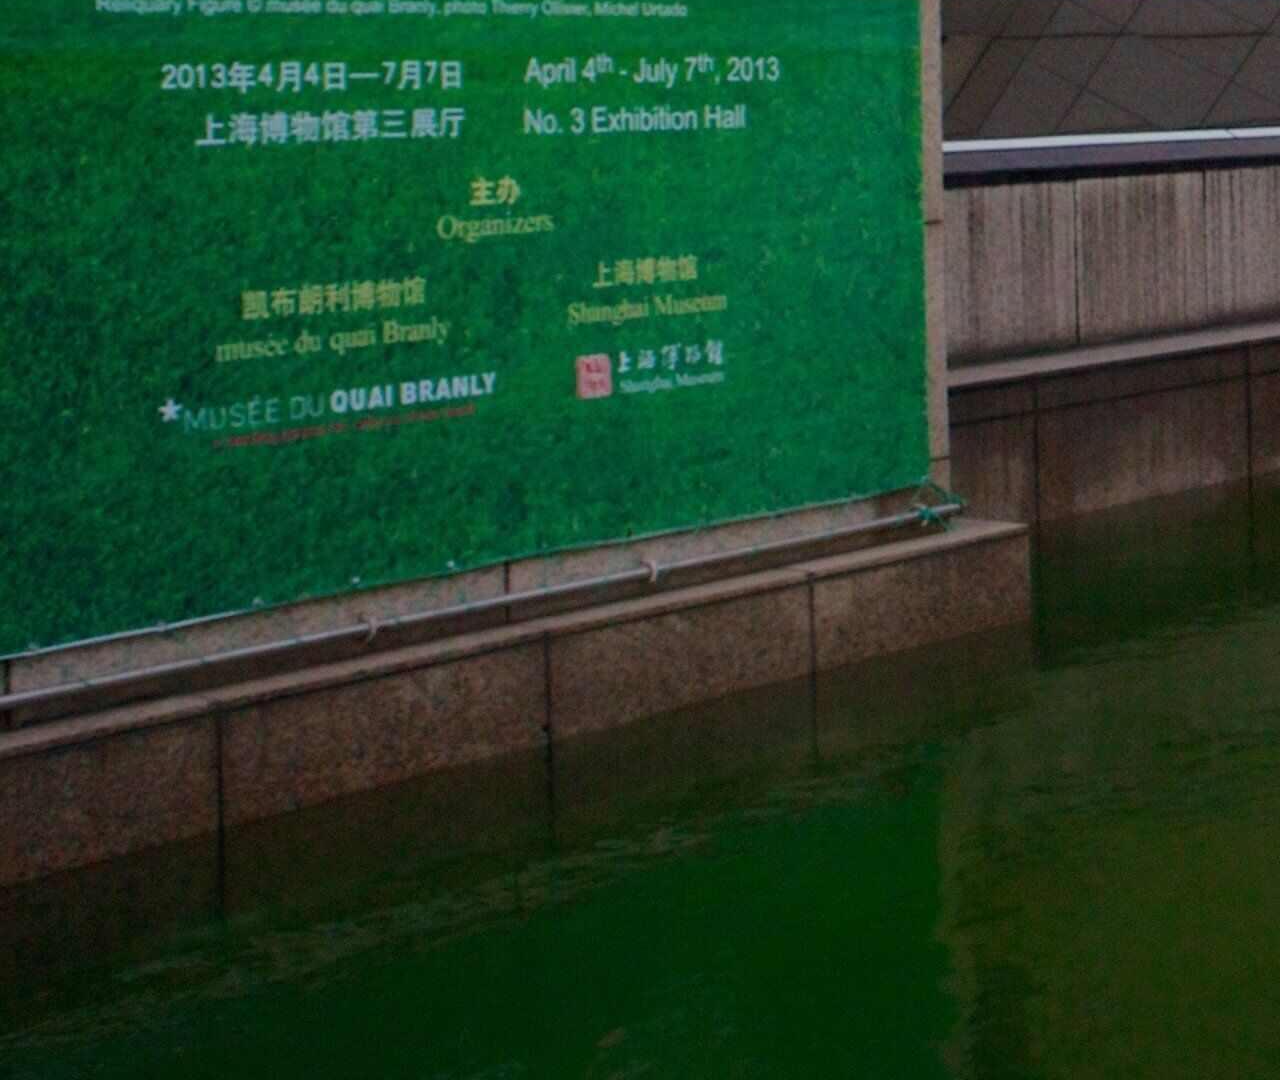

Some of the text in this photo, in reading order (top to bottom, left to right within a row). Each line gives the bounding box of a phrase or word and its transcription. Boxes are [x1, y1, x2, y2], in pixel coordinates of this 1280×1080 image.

[524, 57, 576, 88] April
[633, 58, 677, 88] July
[727, 56, 779, 82] 2013
[195, 108, 463, 146] 上海博物馆第三展厅
[523, 105, 745, 134] No. 3 Exhibition Hall
[470, 176, 520, 206] 主办
[436, 215, 553, 243] Organizers
[568, 294, 727, 325] Shanghai Museum
[383, 317, 447, 344] Branly
[183, 395, 279, 432] MUSÉE
[290, 395, 325, 420] DU
[330, 385, 392, 413] QUAI
[400, 373, 495, 405] BRANLY
